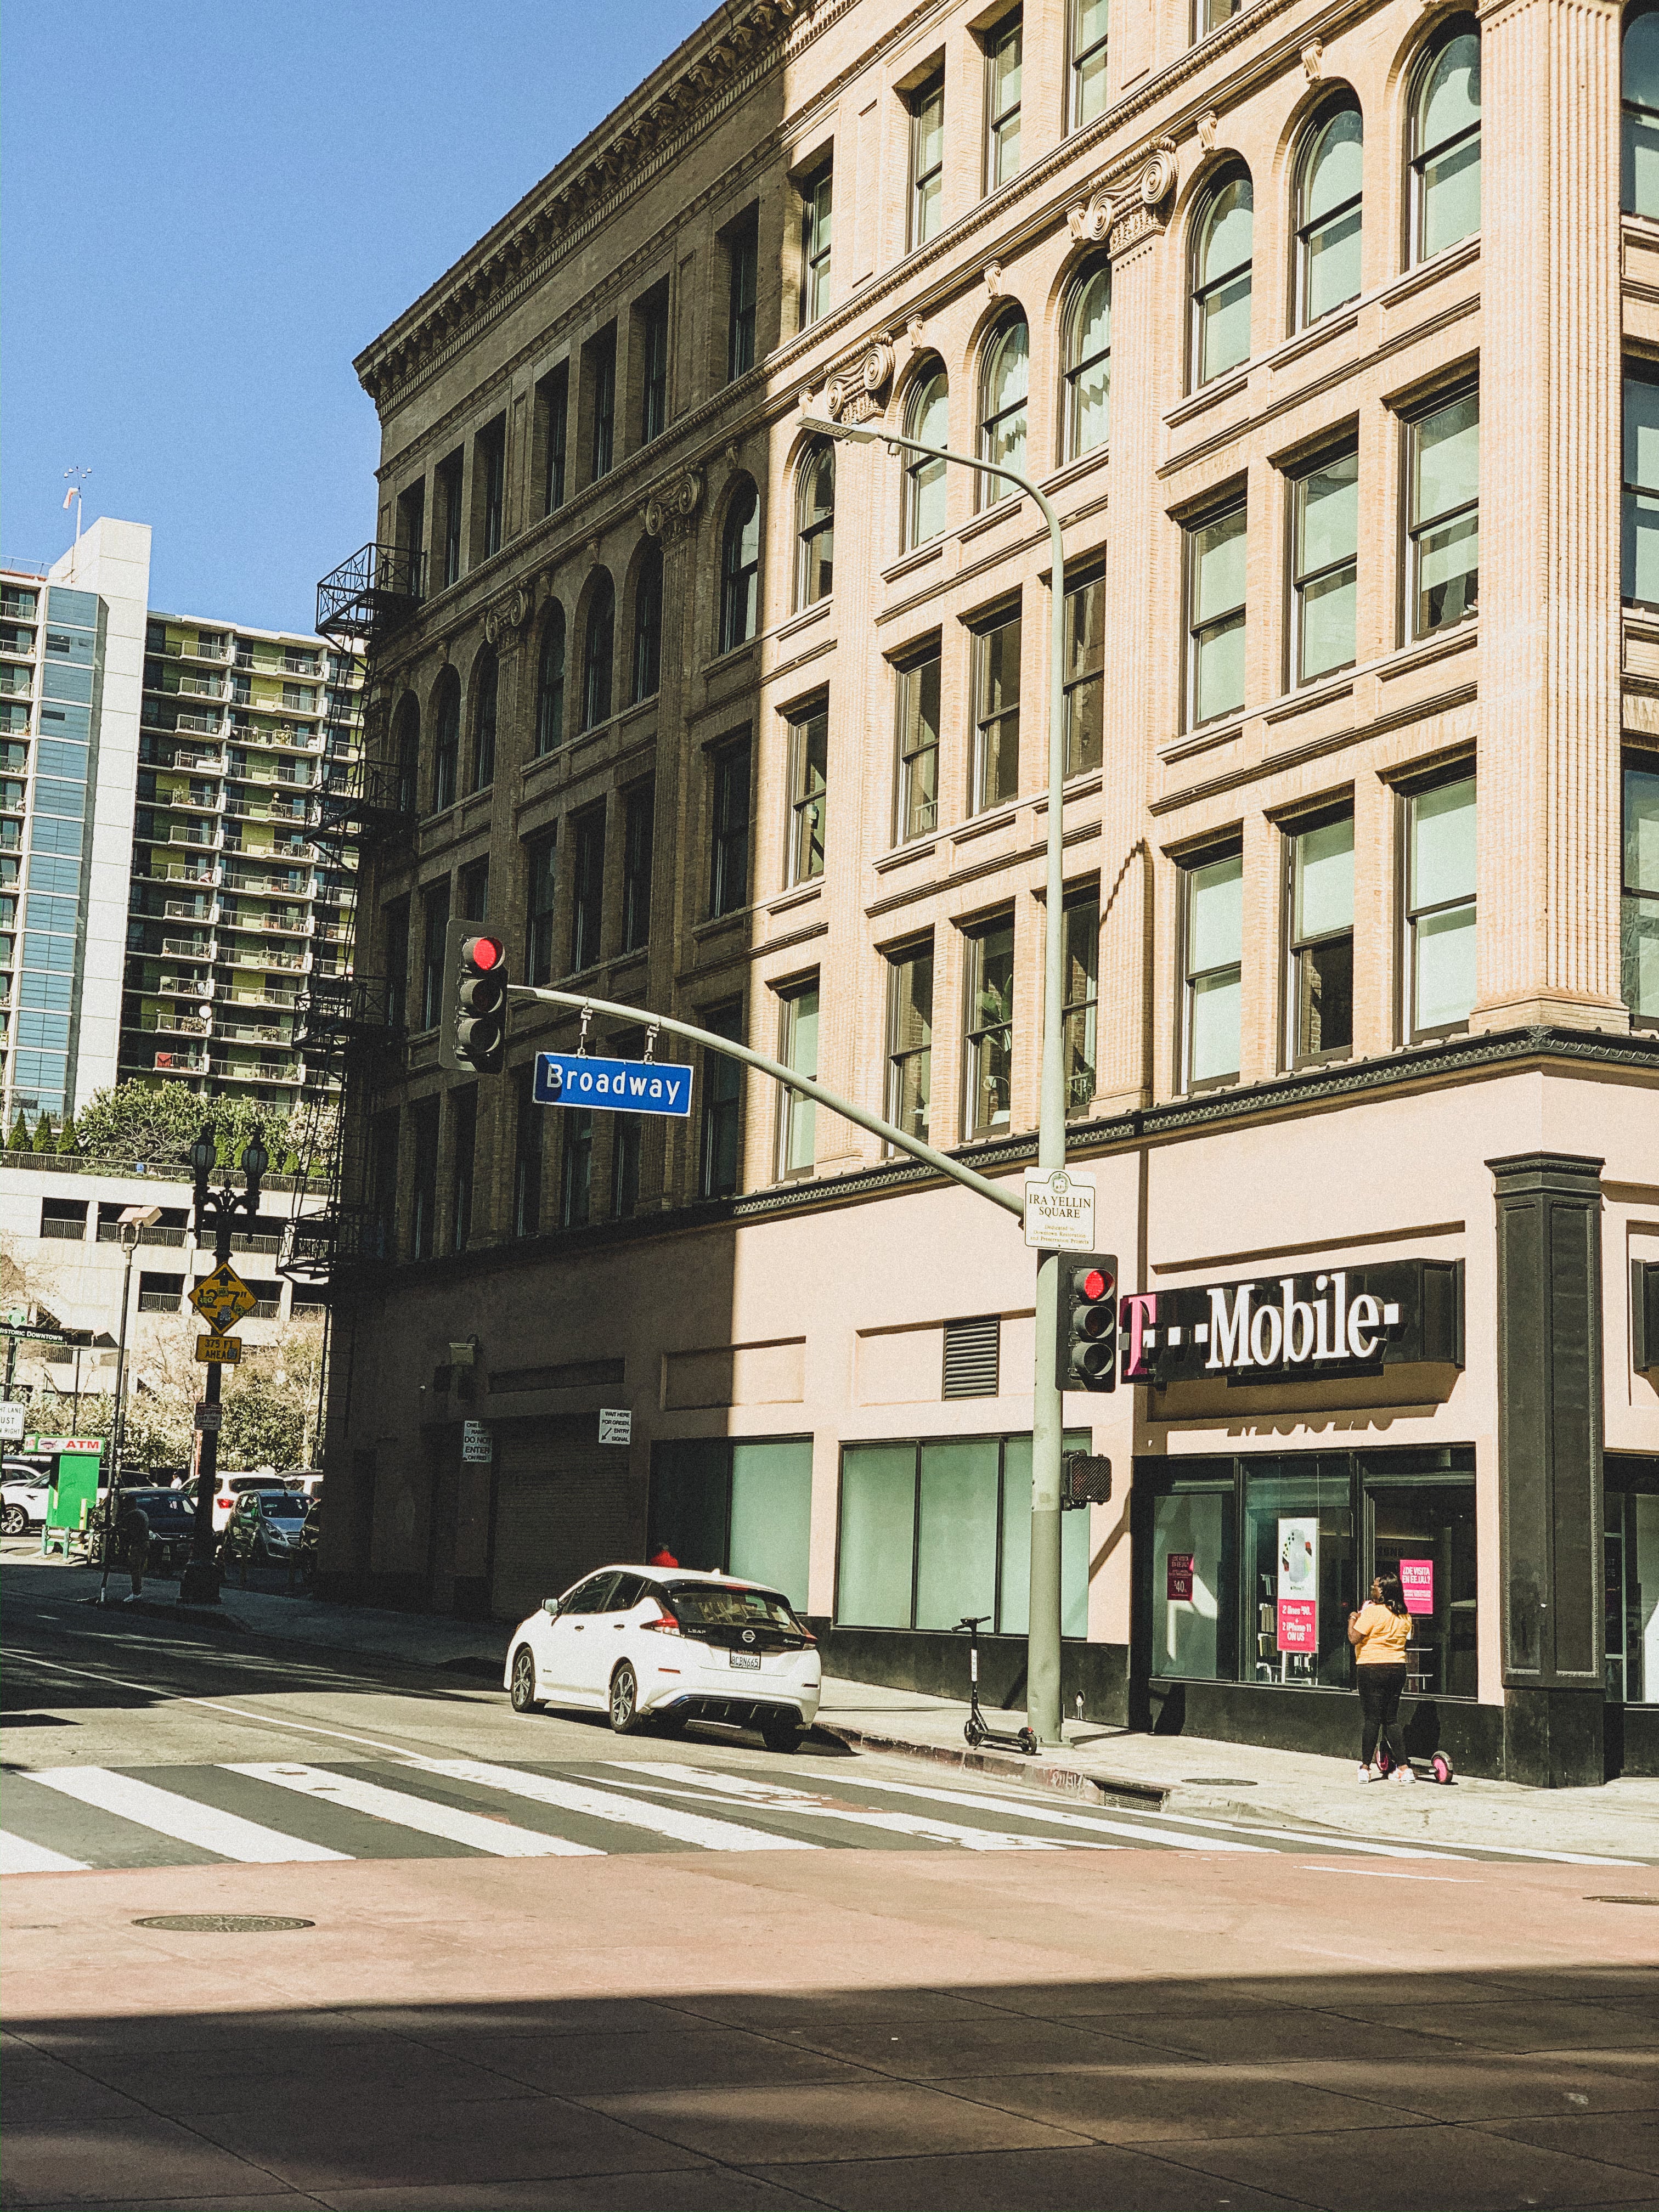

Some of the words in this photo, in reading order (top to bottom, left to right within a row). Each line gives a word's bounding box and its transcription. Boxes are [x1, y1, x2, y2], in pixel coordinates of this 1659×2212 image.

[546, 1064, 681, 1105] Broadway
[1029, 1194, 1047, 1205] IRA
[1051, 1196, 1091, 1208] YELLIN
[1039, 1207, 1080, 1218] SQUARE
[26, 1331, 63, 1341] DOWNTOWN
[205, 1339, 220, 1348] 375
[223, 1340, 234, 1349] FT
[205, 1350, 235, 1359] AHEA
[66, 1440, 99, 1449] ATM
[465, 1446, 490, 1454] ENTER
[1414, 1566, 1430, 1576] VISITA
[1402, 1575, 1410, 1584] EN
[1174, 1580, 1184, 1593] $40
[1282, 1605, 1287, 1615] 2
[1287, 1605, 1301, 1615] lines
[1282, 1622, 1286, 1631] 2
[1286, 1622, 1306, 1632] iPhone
[1286, 1631, 1296, 1641] ON
[1296, 1632, 1305, 1642] US
[731, 1656, 759, 1668] 8CBN665
